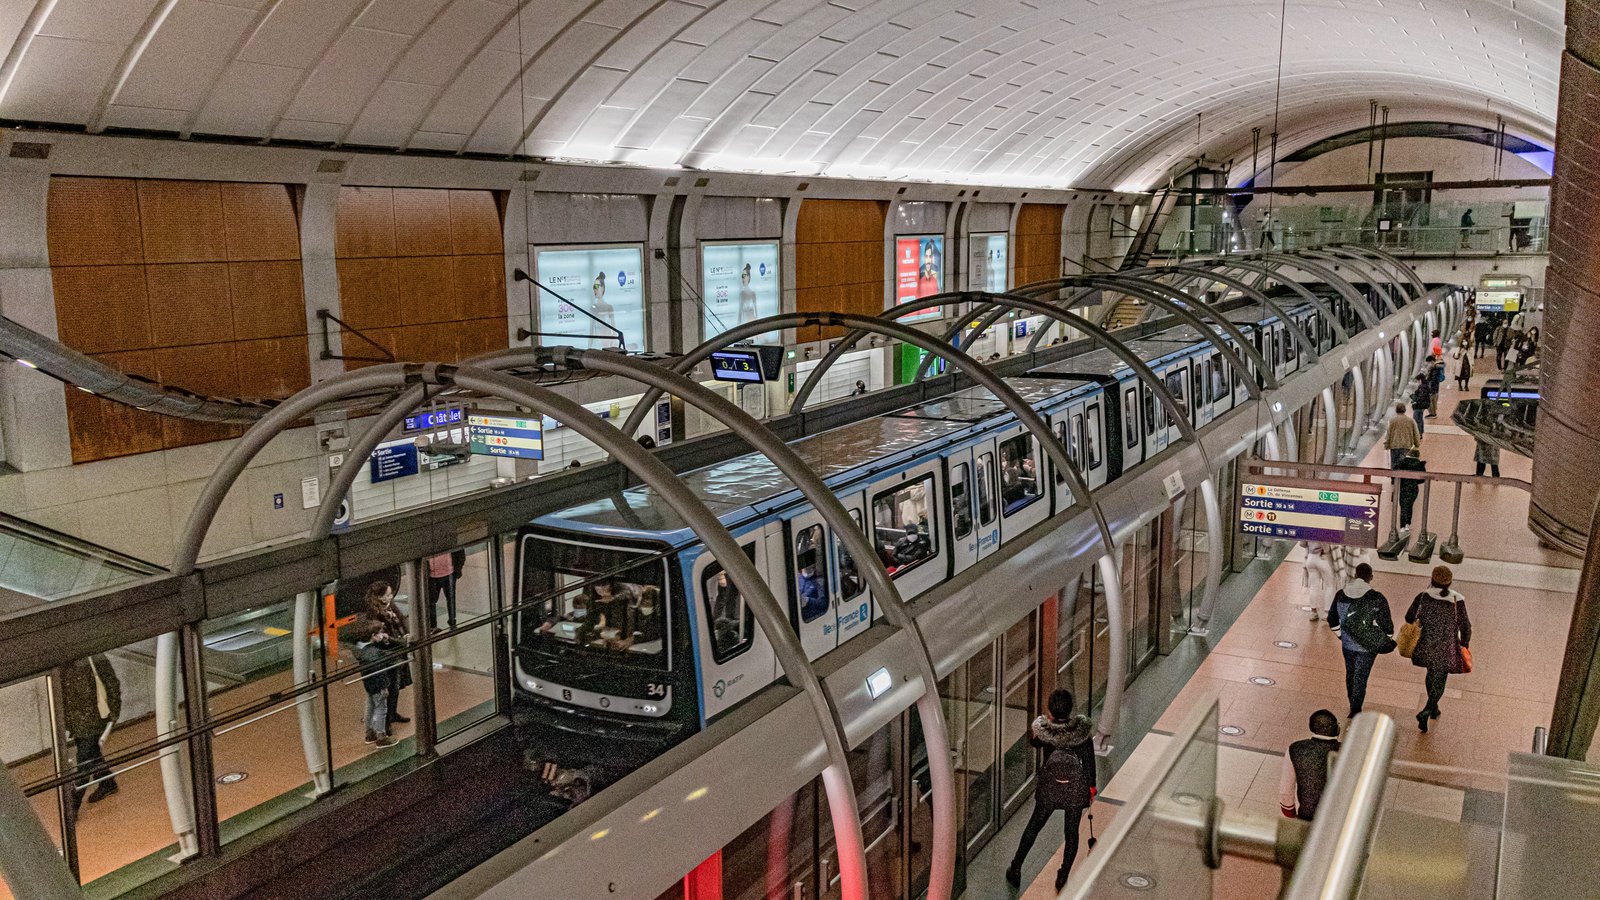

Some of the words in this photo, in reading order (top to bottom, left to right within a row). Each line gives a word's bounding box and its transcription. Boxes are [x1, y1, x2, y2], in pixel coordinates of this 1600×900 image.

[722, 361, 729, 369] 0
[742, 362, 750, 371] 3
[477, 427, 493, 435] Sortie
[377, 448, 393, 457] Sortie
[490, 447, 507, 455] Sortie
[1244, 497, 1273, 509] Sortie
[1243, 523, 1272, 534] Sortie
[838, 609, 859, 625] France
[647, 683, 665, 697] 34
